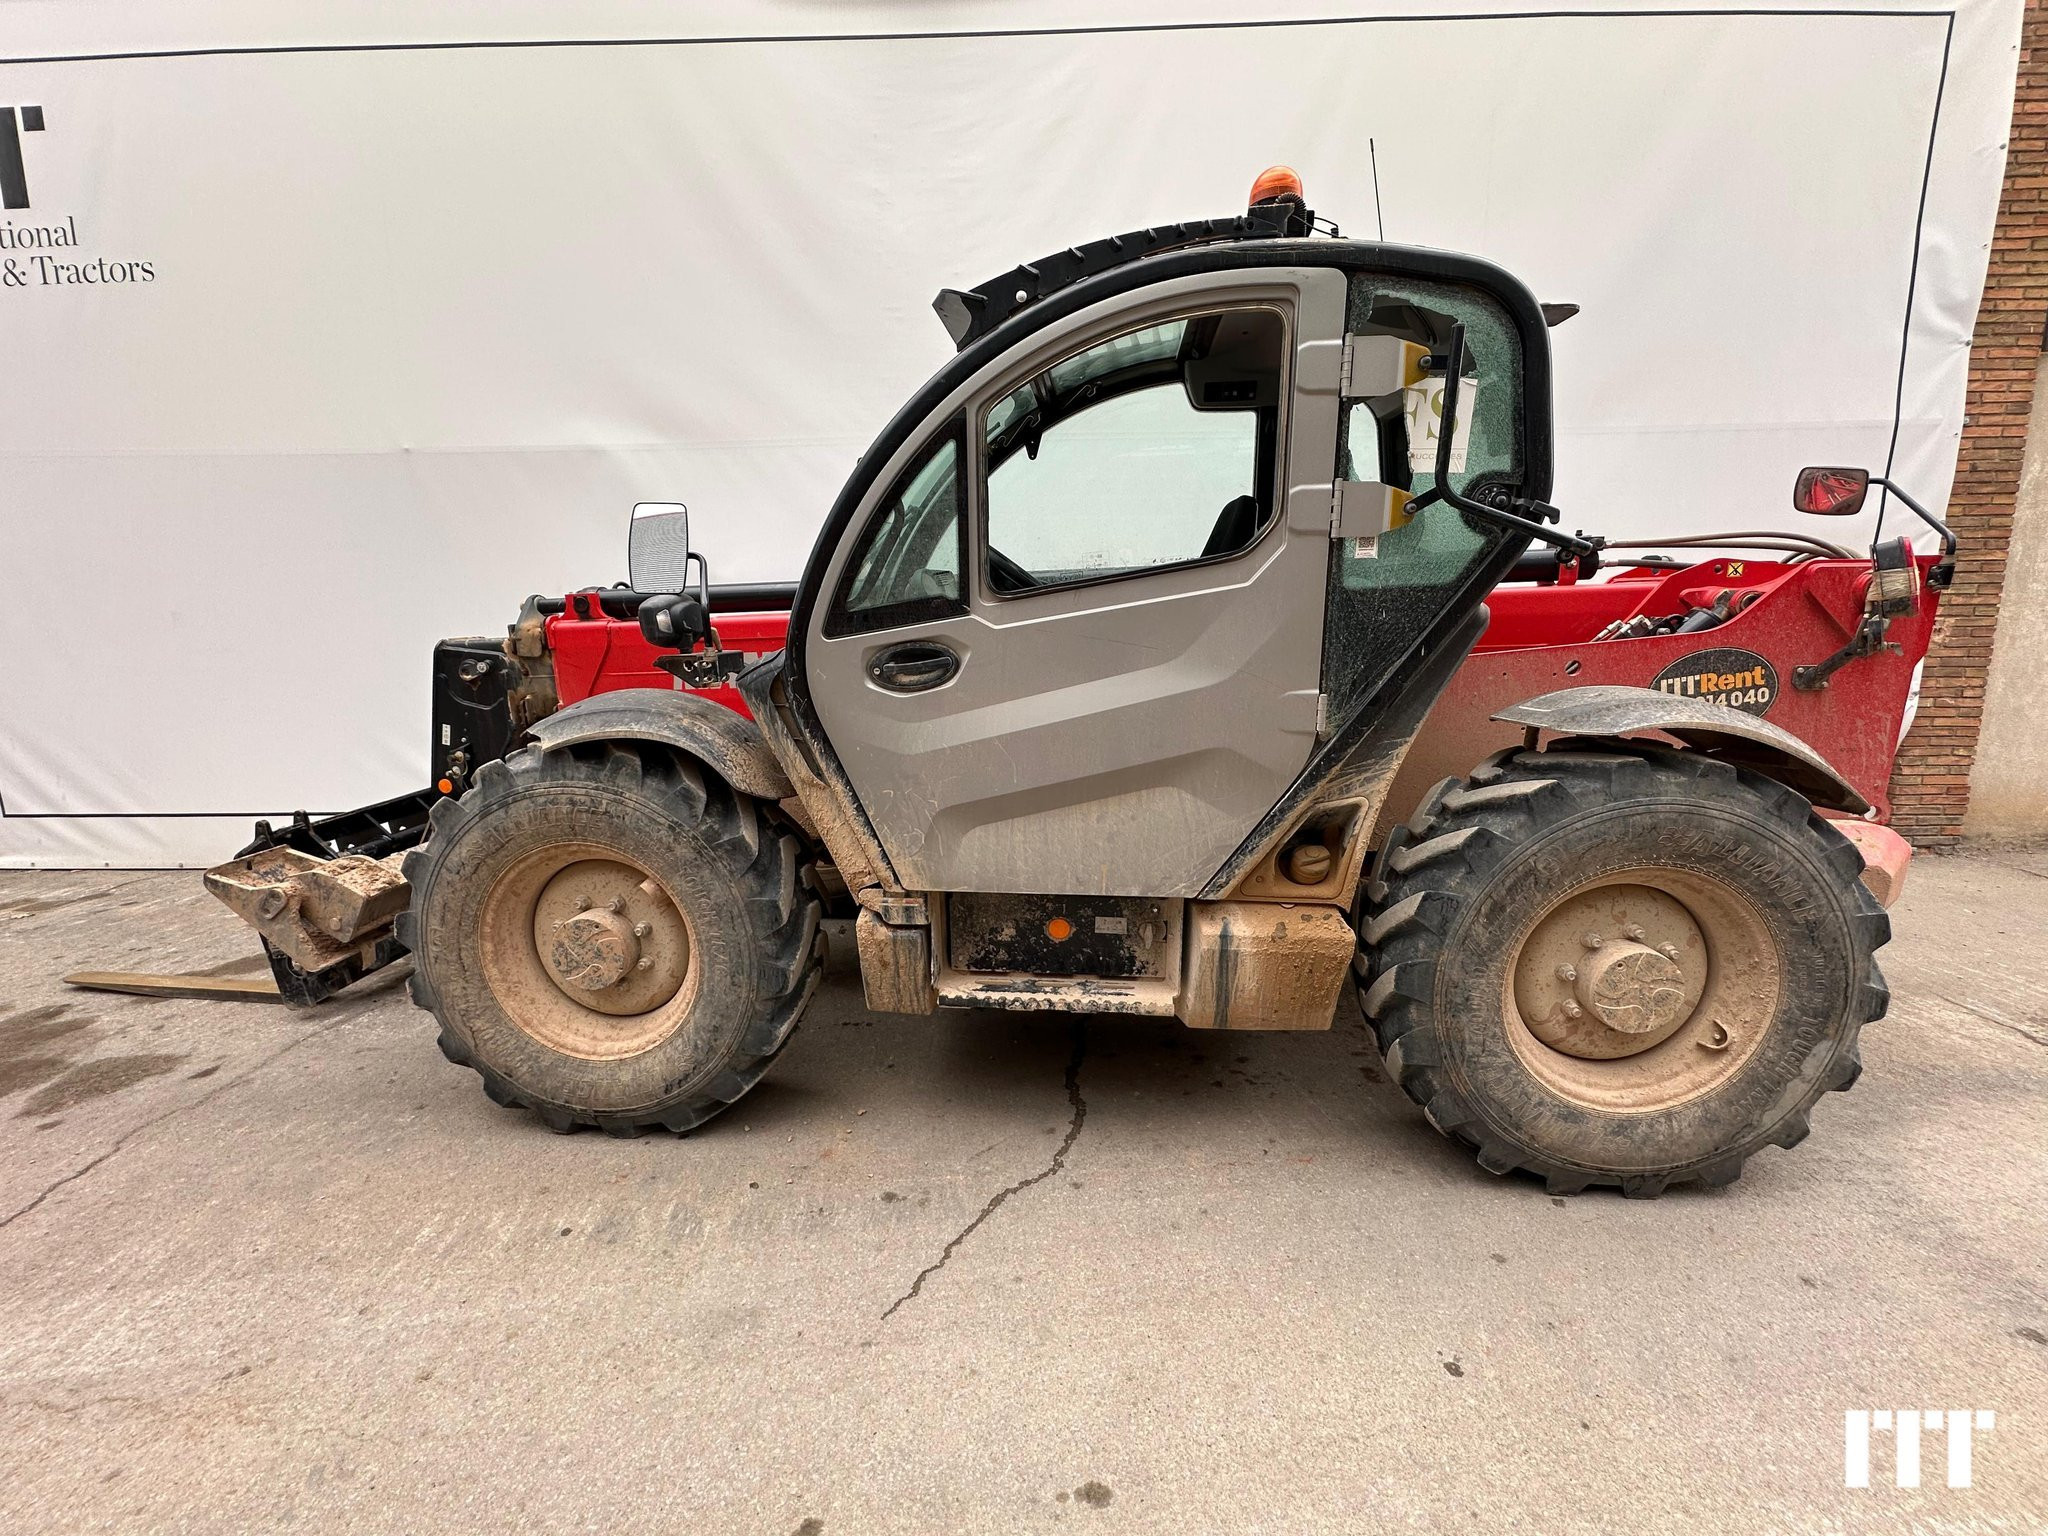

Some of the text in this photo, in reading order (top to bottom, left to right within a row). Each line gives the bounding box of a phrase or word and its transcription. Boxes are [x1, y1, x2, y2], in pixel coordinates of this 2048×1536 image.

[2, 255, 156, 287] & Tractors
[1681, 829, 1823, 924] ALLIANCE
